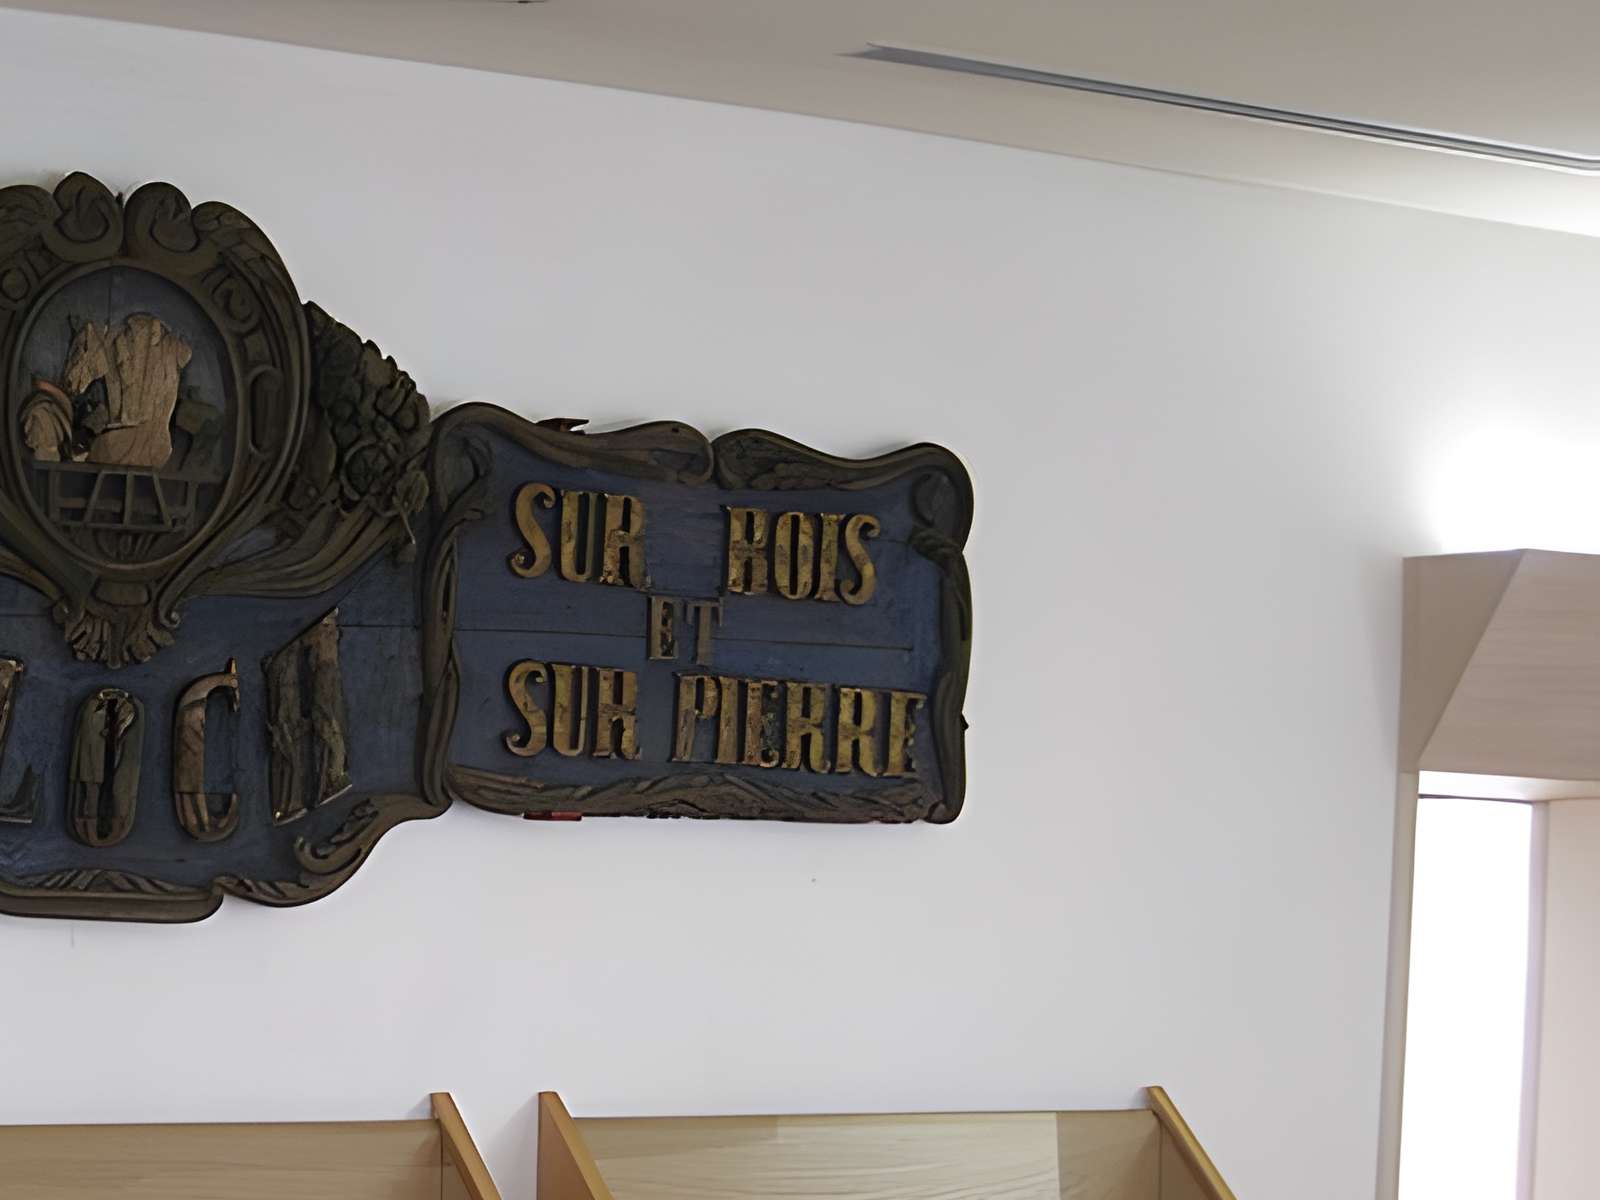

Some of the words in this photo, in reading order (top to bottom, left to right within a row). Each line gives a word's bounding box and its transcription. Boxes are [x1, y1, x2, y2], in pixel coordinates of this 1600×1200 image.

[505, 482, 652, 592] SUR
[722, 505, 881, 606] BOIS
[647, 595, 724, 665] ET
[505, 660, 641, 761] SUR
[668, 671, 928, 779] PIERRE
